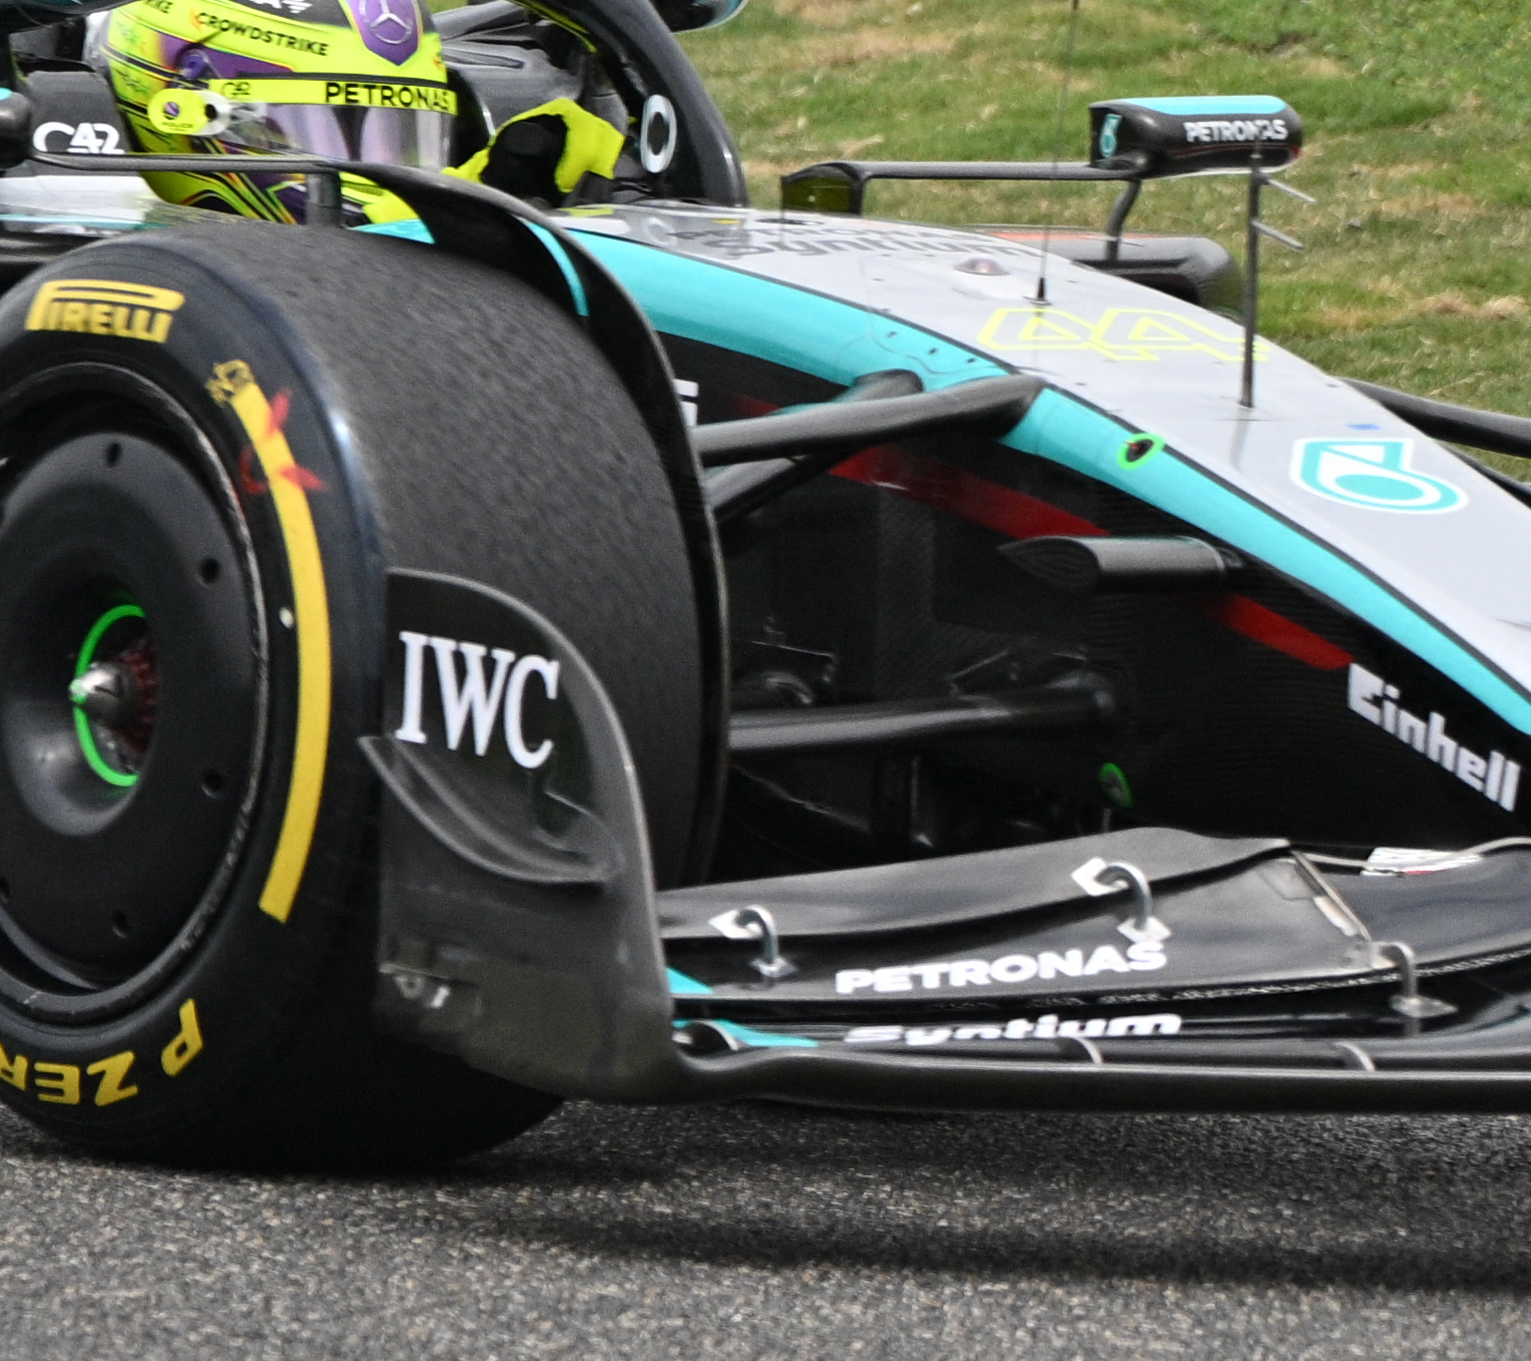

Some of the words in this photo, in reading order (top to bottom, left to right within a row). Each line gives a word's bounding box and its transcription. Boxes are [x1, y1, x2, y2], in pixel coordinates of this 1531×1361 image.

[197, 11, 330, 58] CROWDSTRIKE
[325, 82, 450, 112] PETRONAS
[1182, 119, 1289, 143] PETRONAS
[24, 279, 186, 345] PIRELLI
[395, 629, 561, 771] IWC
[1347, 662, 1522, 813] Einhell
[835, 942, 1167, 995] PETRONAS
[160, 997, 205, 1077] P
